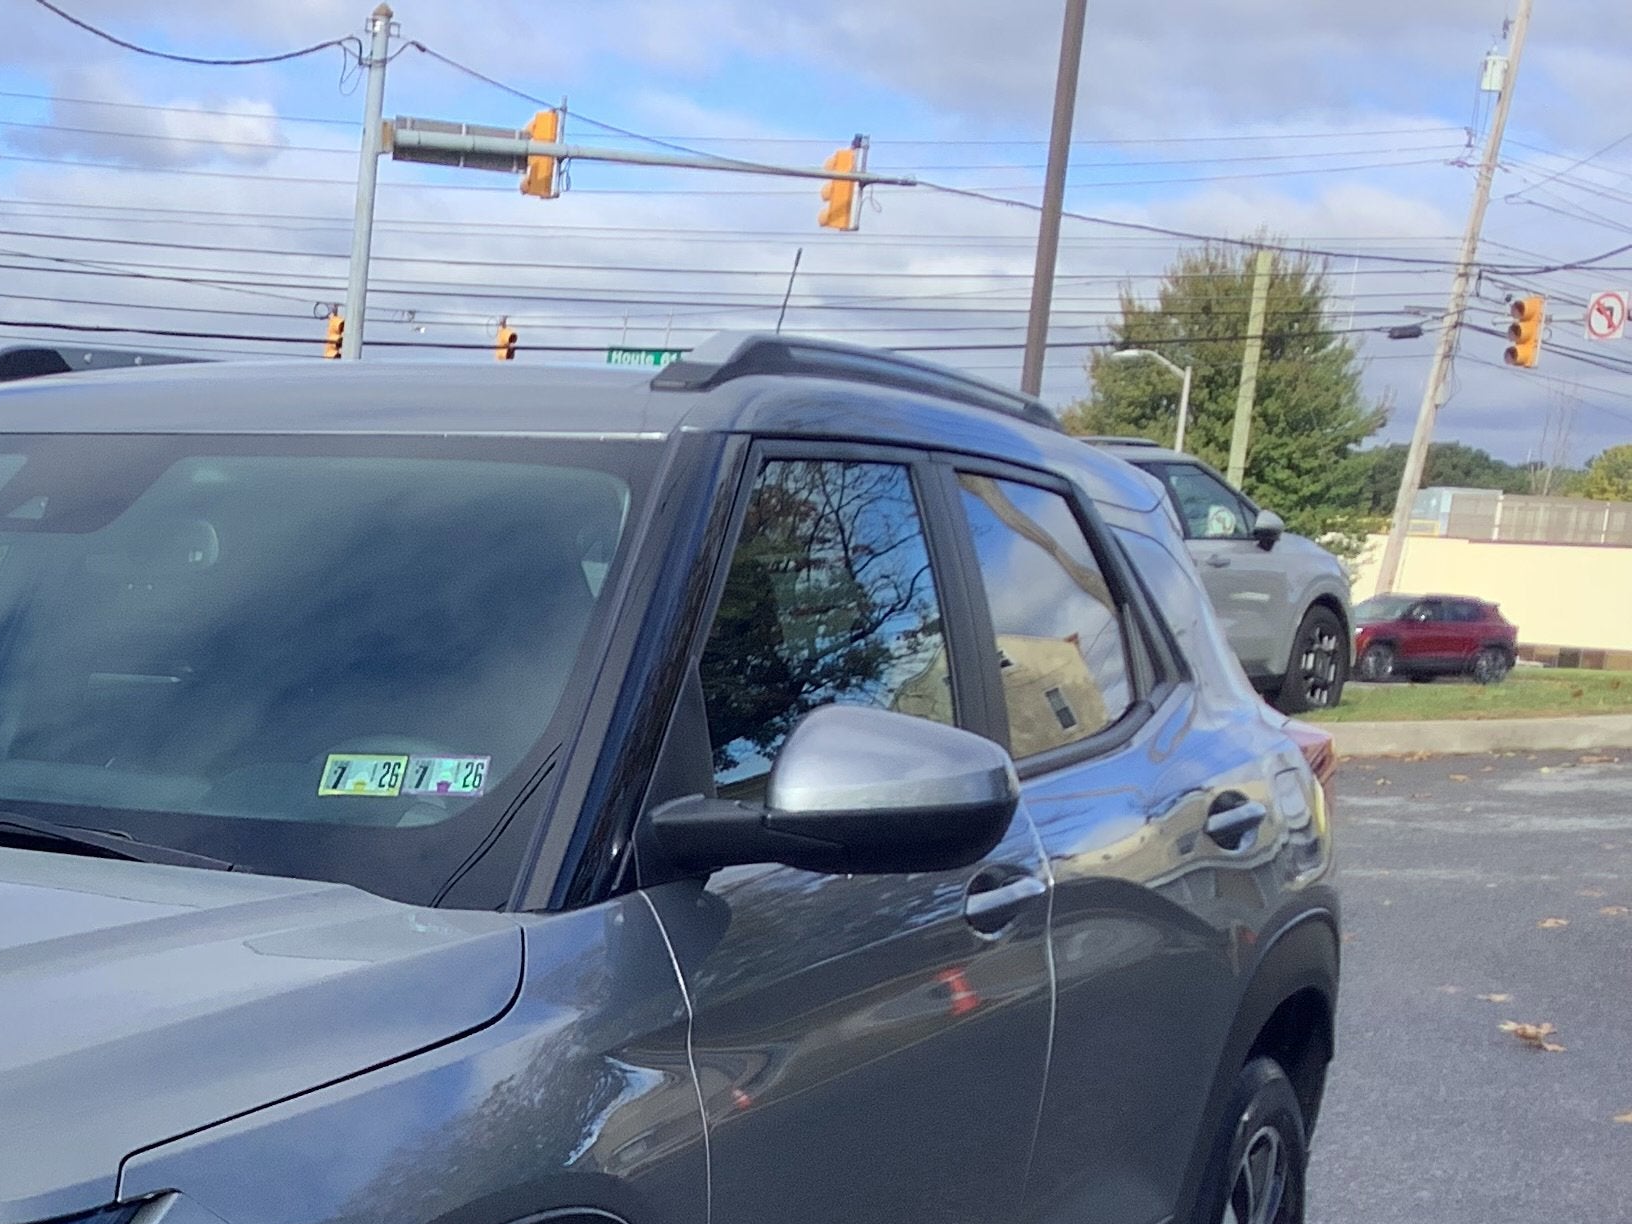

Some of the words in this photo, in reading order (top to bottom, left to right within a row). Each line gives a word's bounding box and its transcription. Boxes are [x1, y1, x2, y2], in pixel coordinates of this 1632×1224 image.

[332, 765, 347, 790] 7
[378, 761, 402, 789] 26
[414, 764, 429, 790] 7
[461, 761, 485, 789] 26
